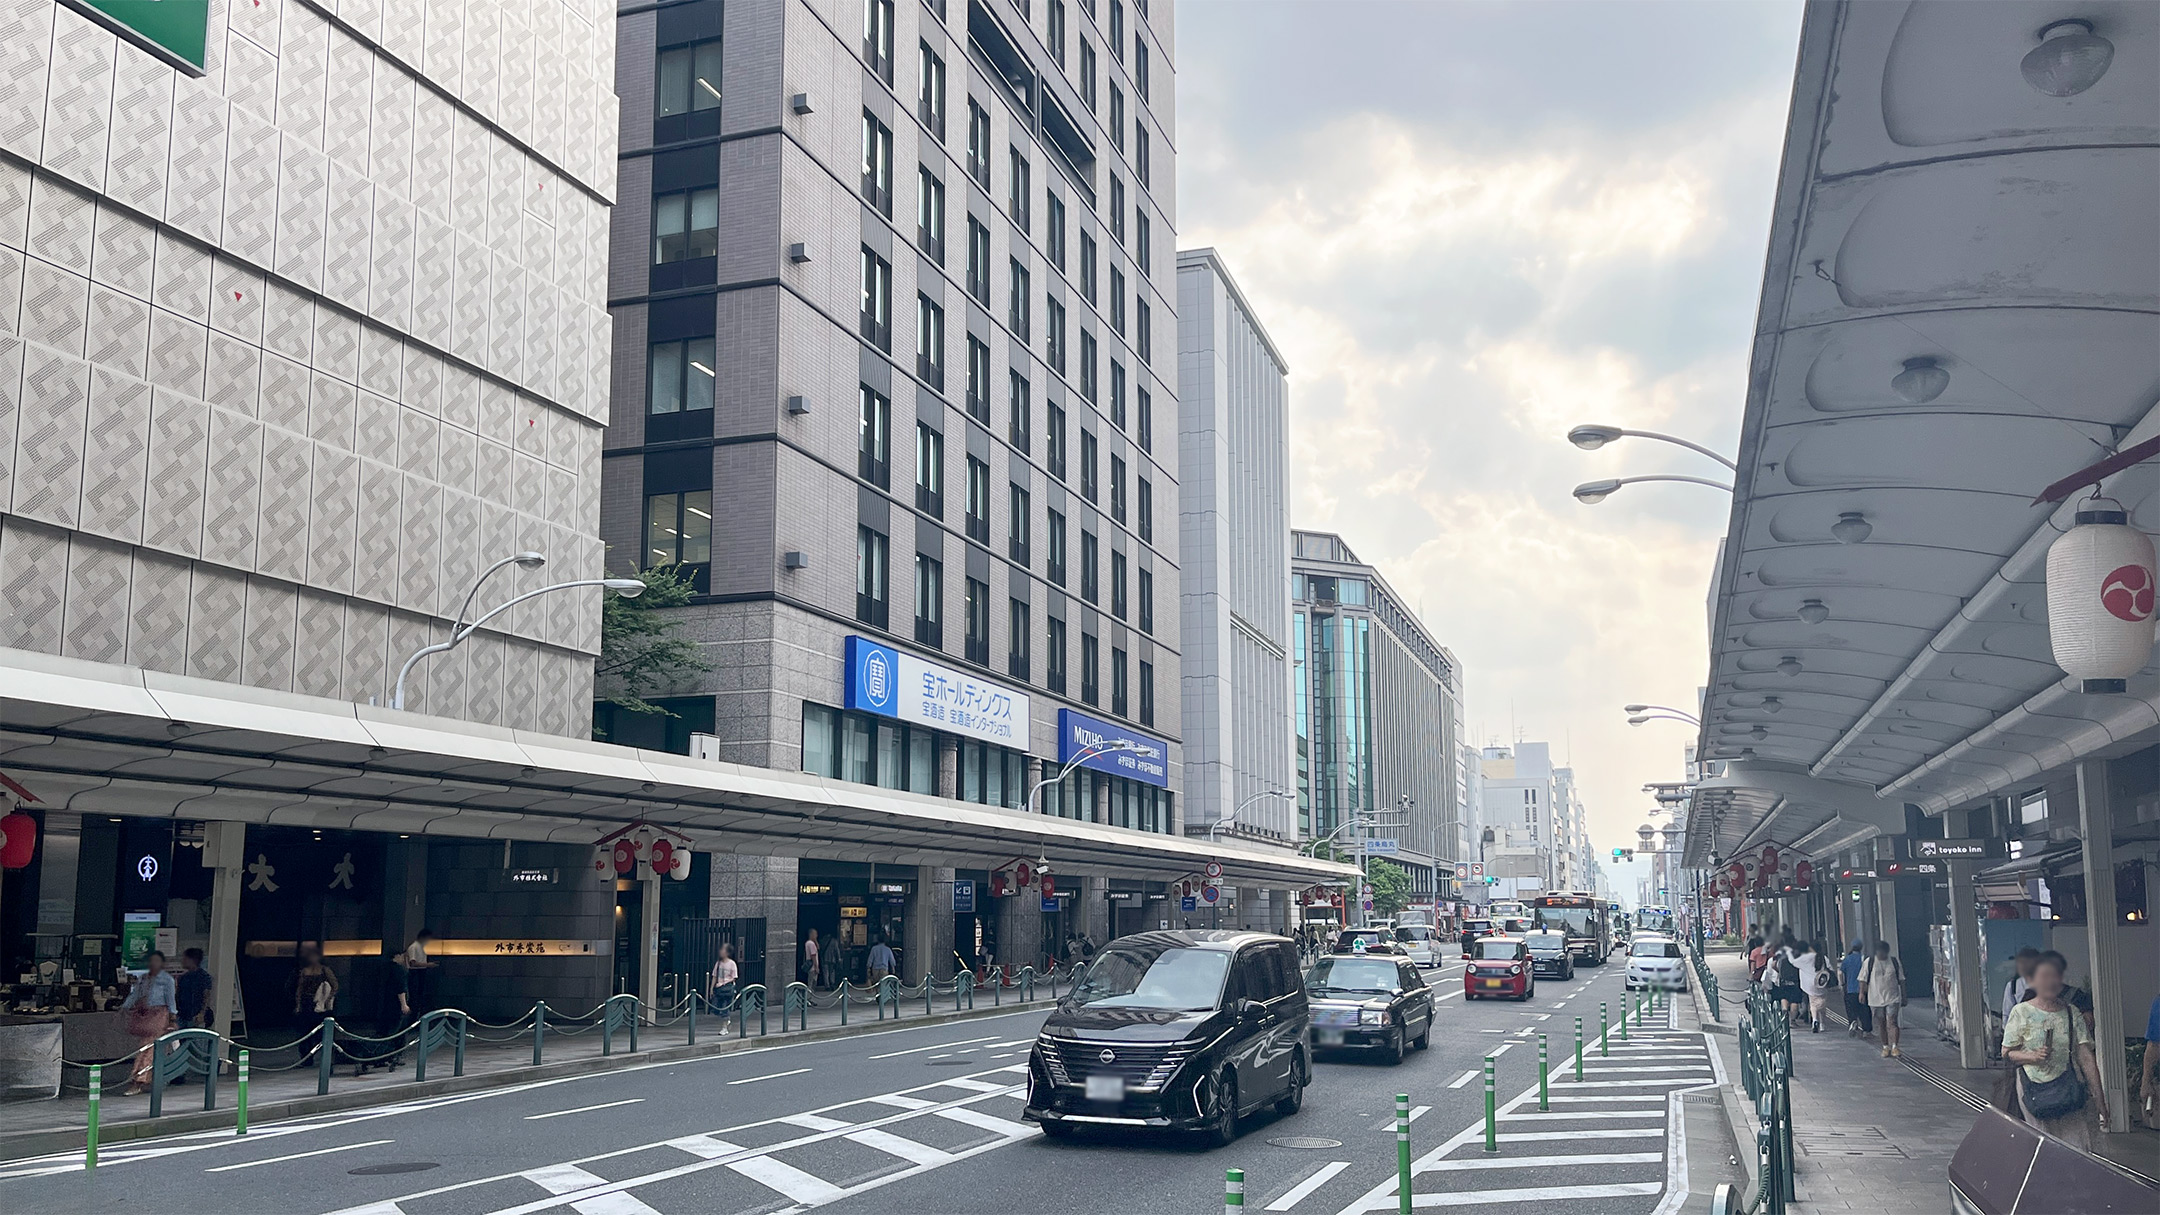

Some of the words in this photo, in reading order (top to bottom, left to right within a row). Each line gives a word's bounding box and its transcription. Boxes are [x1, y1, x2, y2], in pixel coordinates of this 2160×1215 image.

[922, 671, 1012, 721] 宝ホールディングス
[922, 701, 945, 721] 宝酒造
[949, 709, 1012, 738] 宝酒造インターナショナル
[1938, 846, 1967, 855] toyoko
